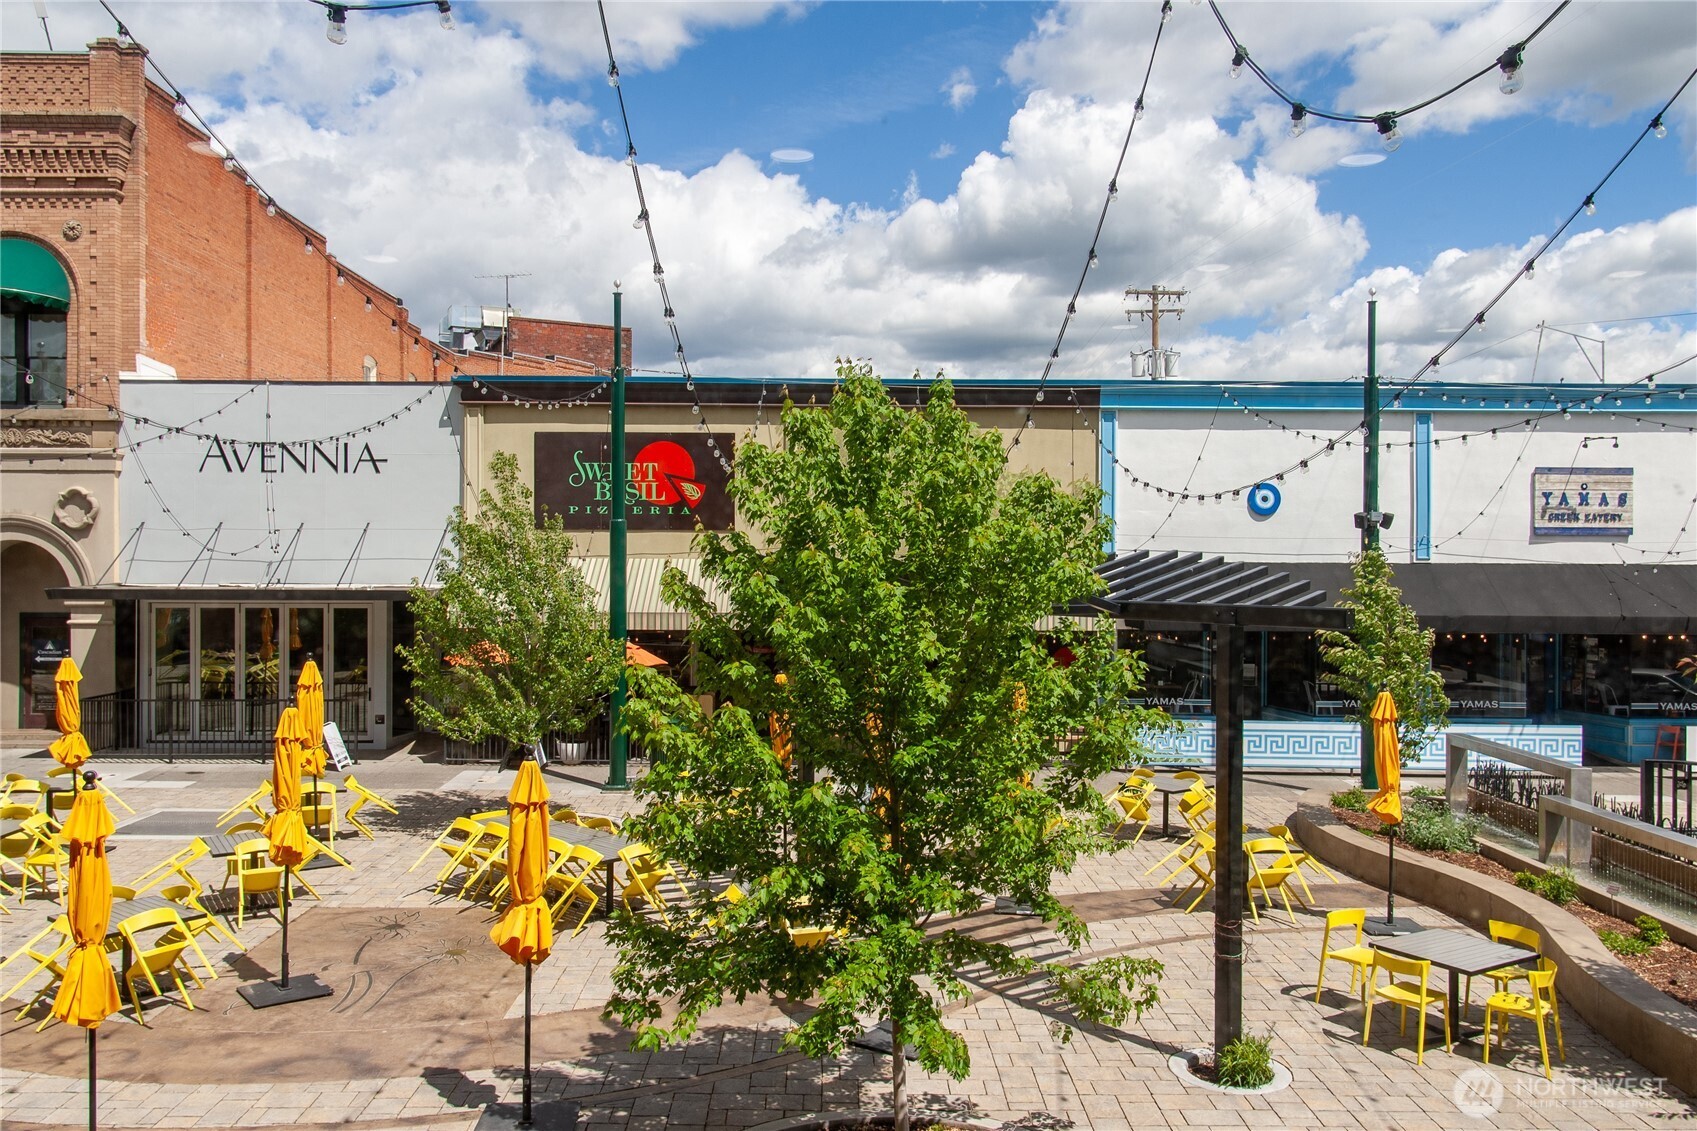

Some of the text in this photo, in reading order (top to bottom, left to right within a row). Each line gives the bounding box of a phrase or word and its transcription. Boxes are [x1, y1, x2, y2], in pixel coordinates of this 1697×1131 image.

[199, 433, 388, 474] AVENNIA
[568, 450, 659, 487] SWET
[594, 481, 666, 505] BSIL
[1541, 491, 1628, 508] YAMAS
[568, 505, 691, 515] PIZERIA
[1548, 512, 1623, 524] GREEK EATERY
[1145, 697, 1184, 705] YAMAS
[1460, 700, 1499, 709] YAMAS
[1660, 702, 1697, 710] YAMAS
